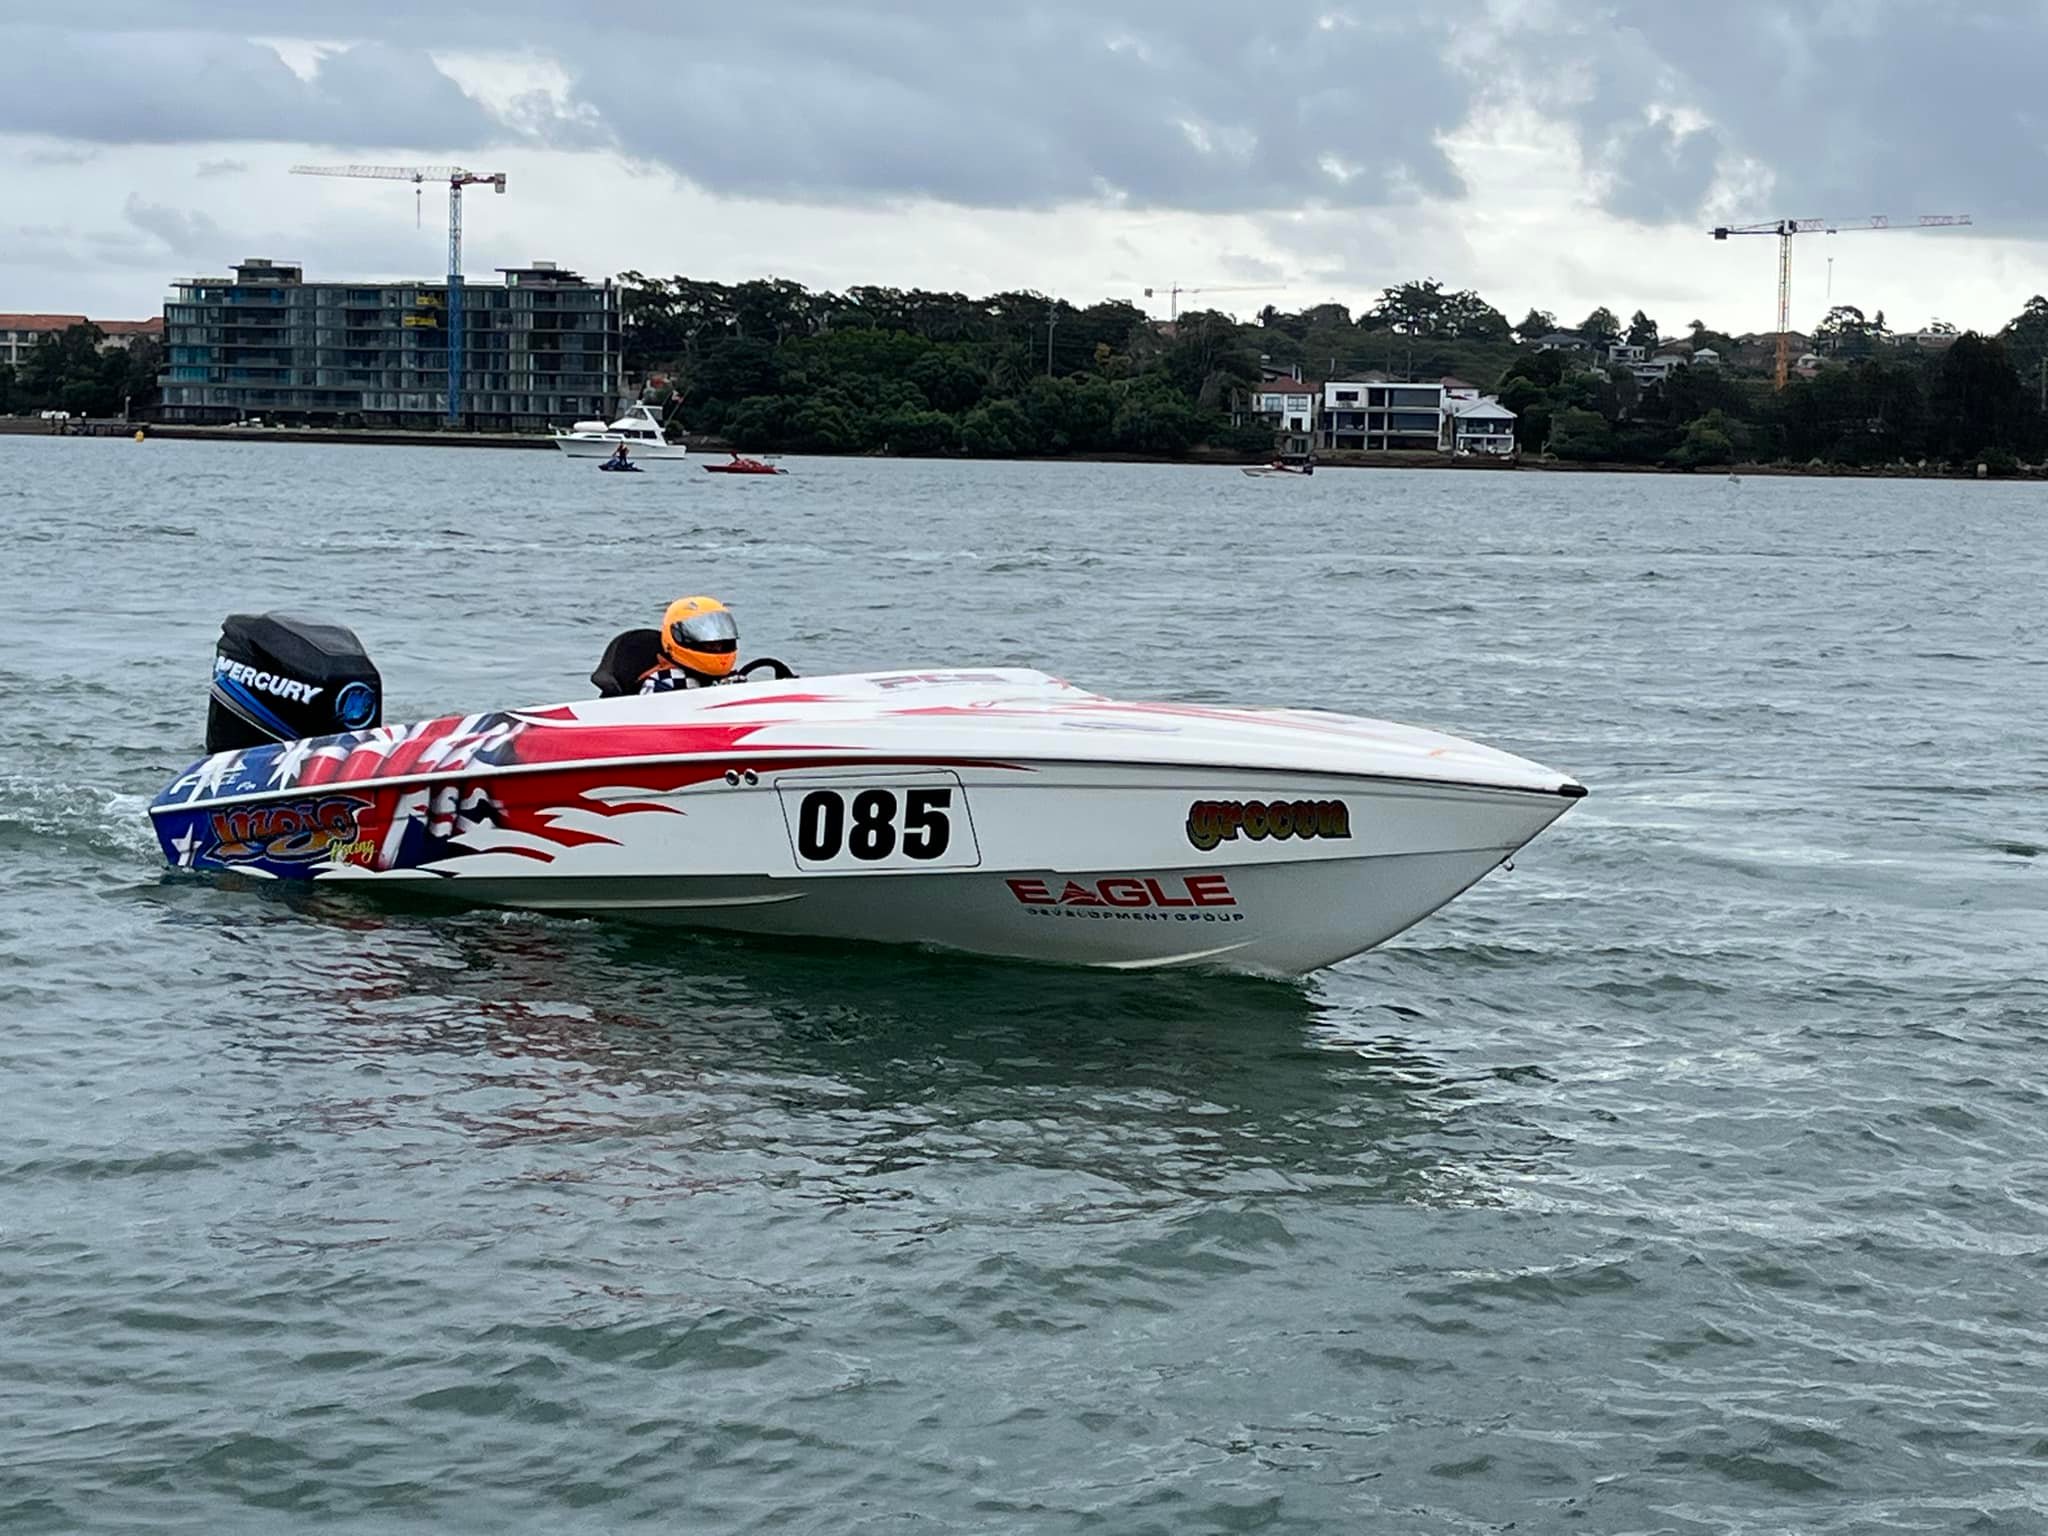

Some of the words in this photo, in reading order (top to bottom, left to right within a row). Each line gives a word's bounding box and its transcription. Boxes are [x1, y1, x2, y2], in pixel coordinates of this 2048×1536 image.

[214, 655, 324, 705] MERCURY
[798, 788, 952, 861] 085
[1005, 874, 1237, 907] EAGLE
[1026, 907, 1169, 921] DEVELOPMENT
[1174, 912, 1245, 922] GROUP
